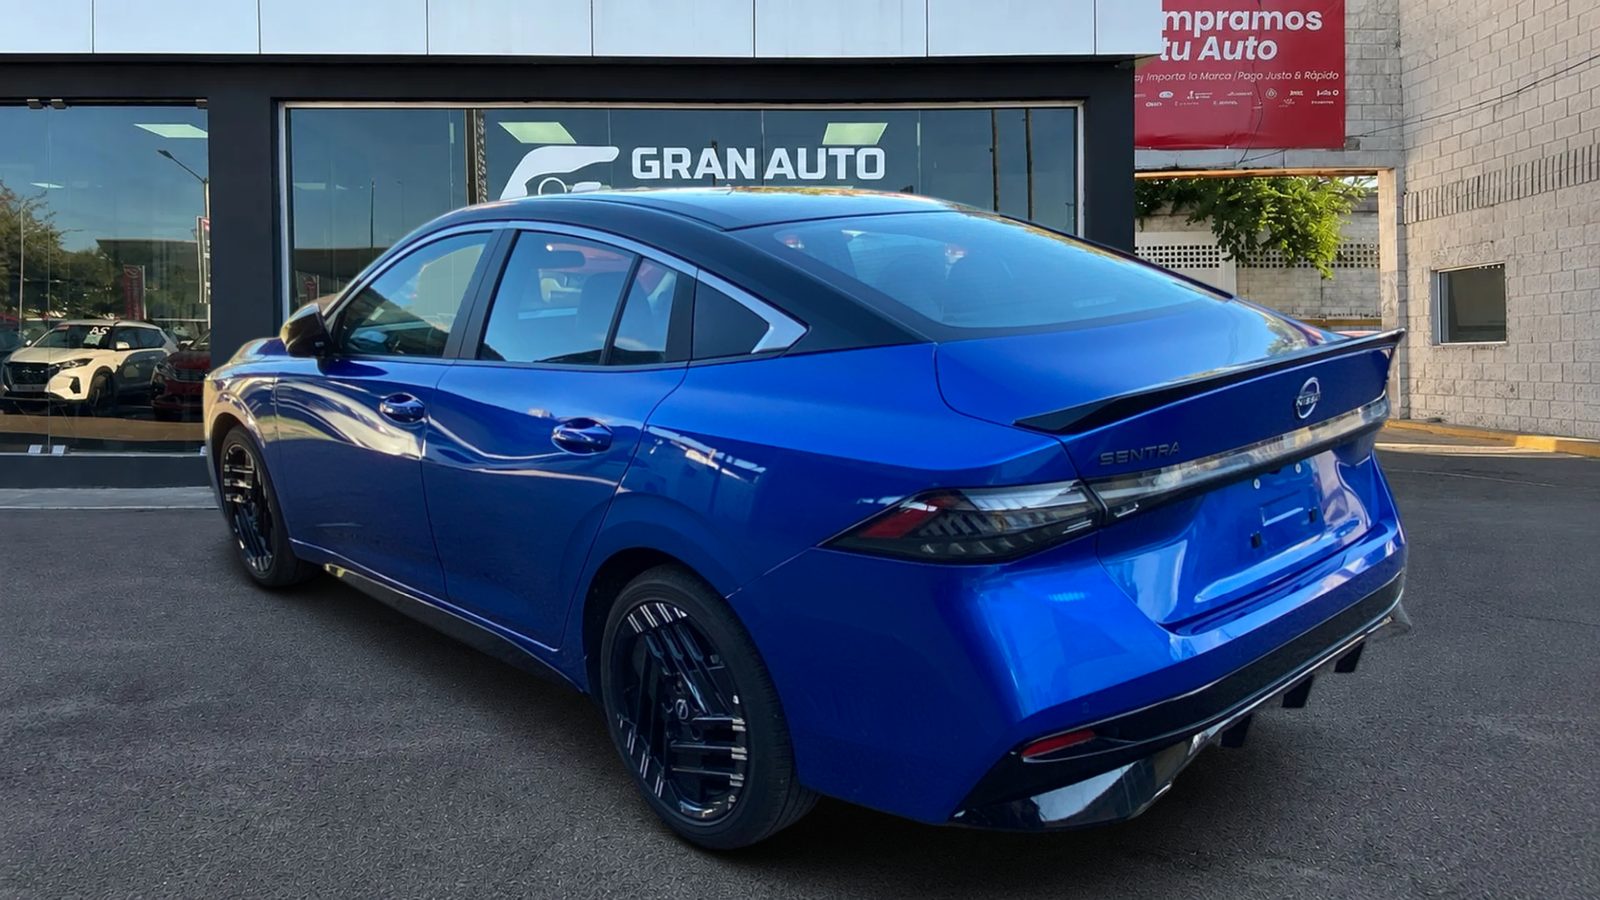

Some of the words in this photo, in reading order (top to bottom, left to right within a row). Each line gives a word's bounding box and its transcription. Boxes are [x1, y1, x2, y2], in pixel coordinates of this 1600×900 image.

[1160, 37, 1192, 61] tu
[1197, 35, 1278, 61] Auto
[1146, 72, 1186, 83] Importa
[1188, 71, 1198, 80] la
[1199, 72, 1232, 81] Marca
[1265, 71, 1293, 80] Justo
[631, 146, 756, 180] GRAN
[763, 146, 887, 180] AUTO
[1099, 441, 1180, 466] SENTRA
